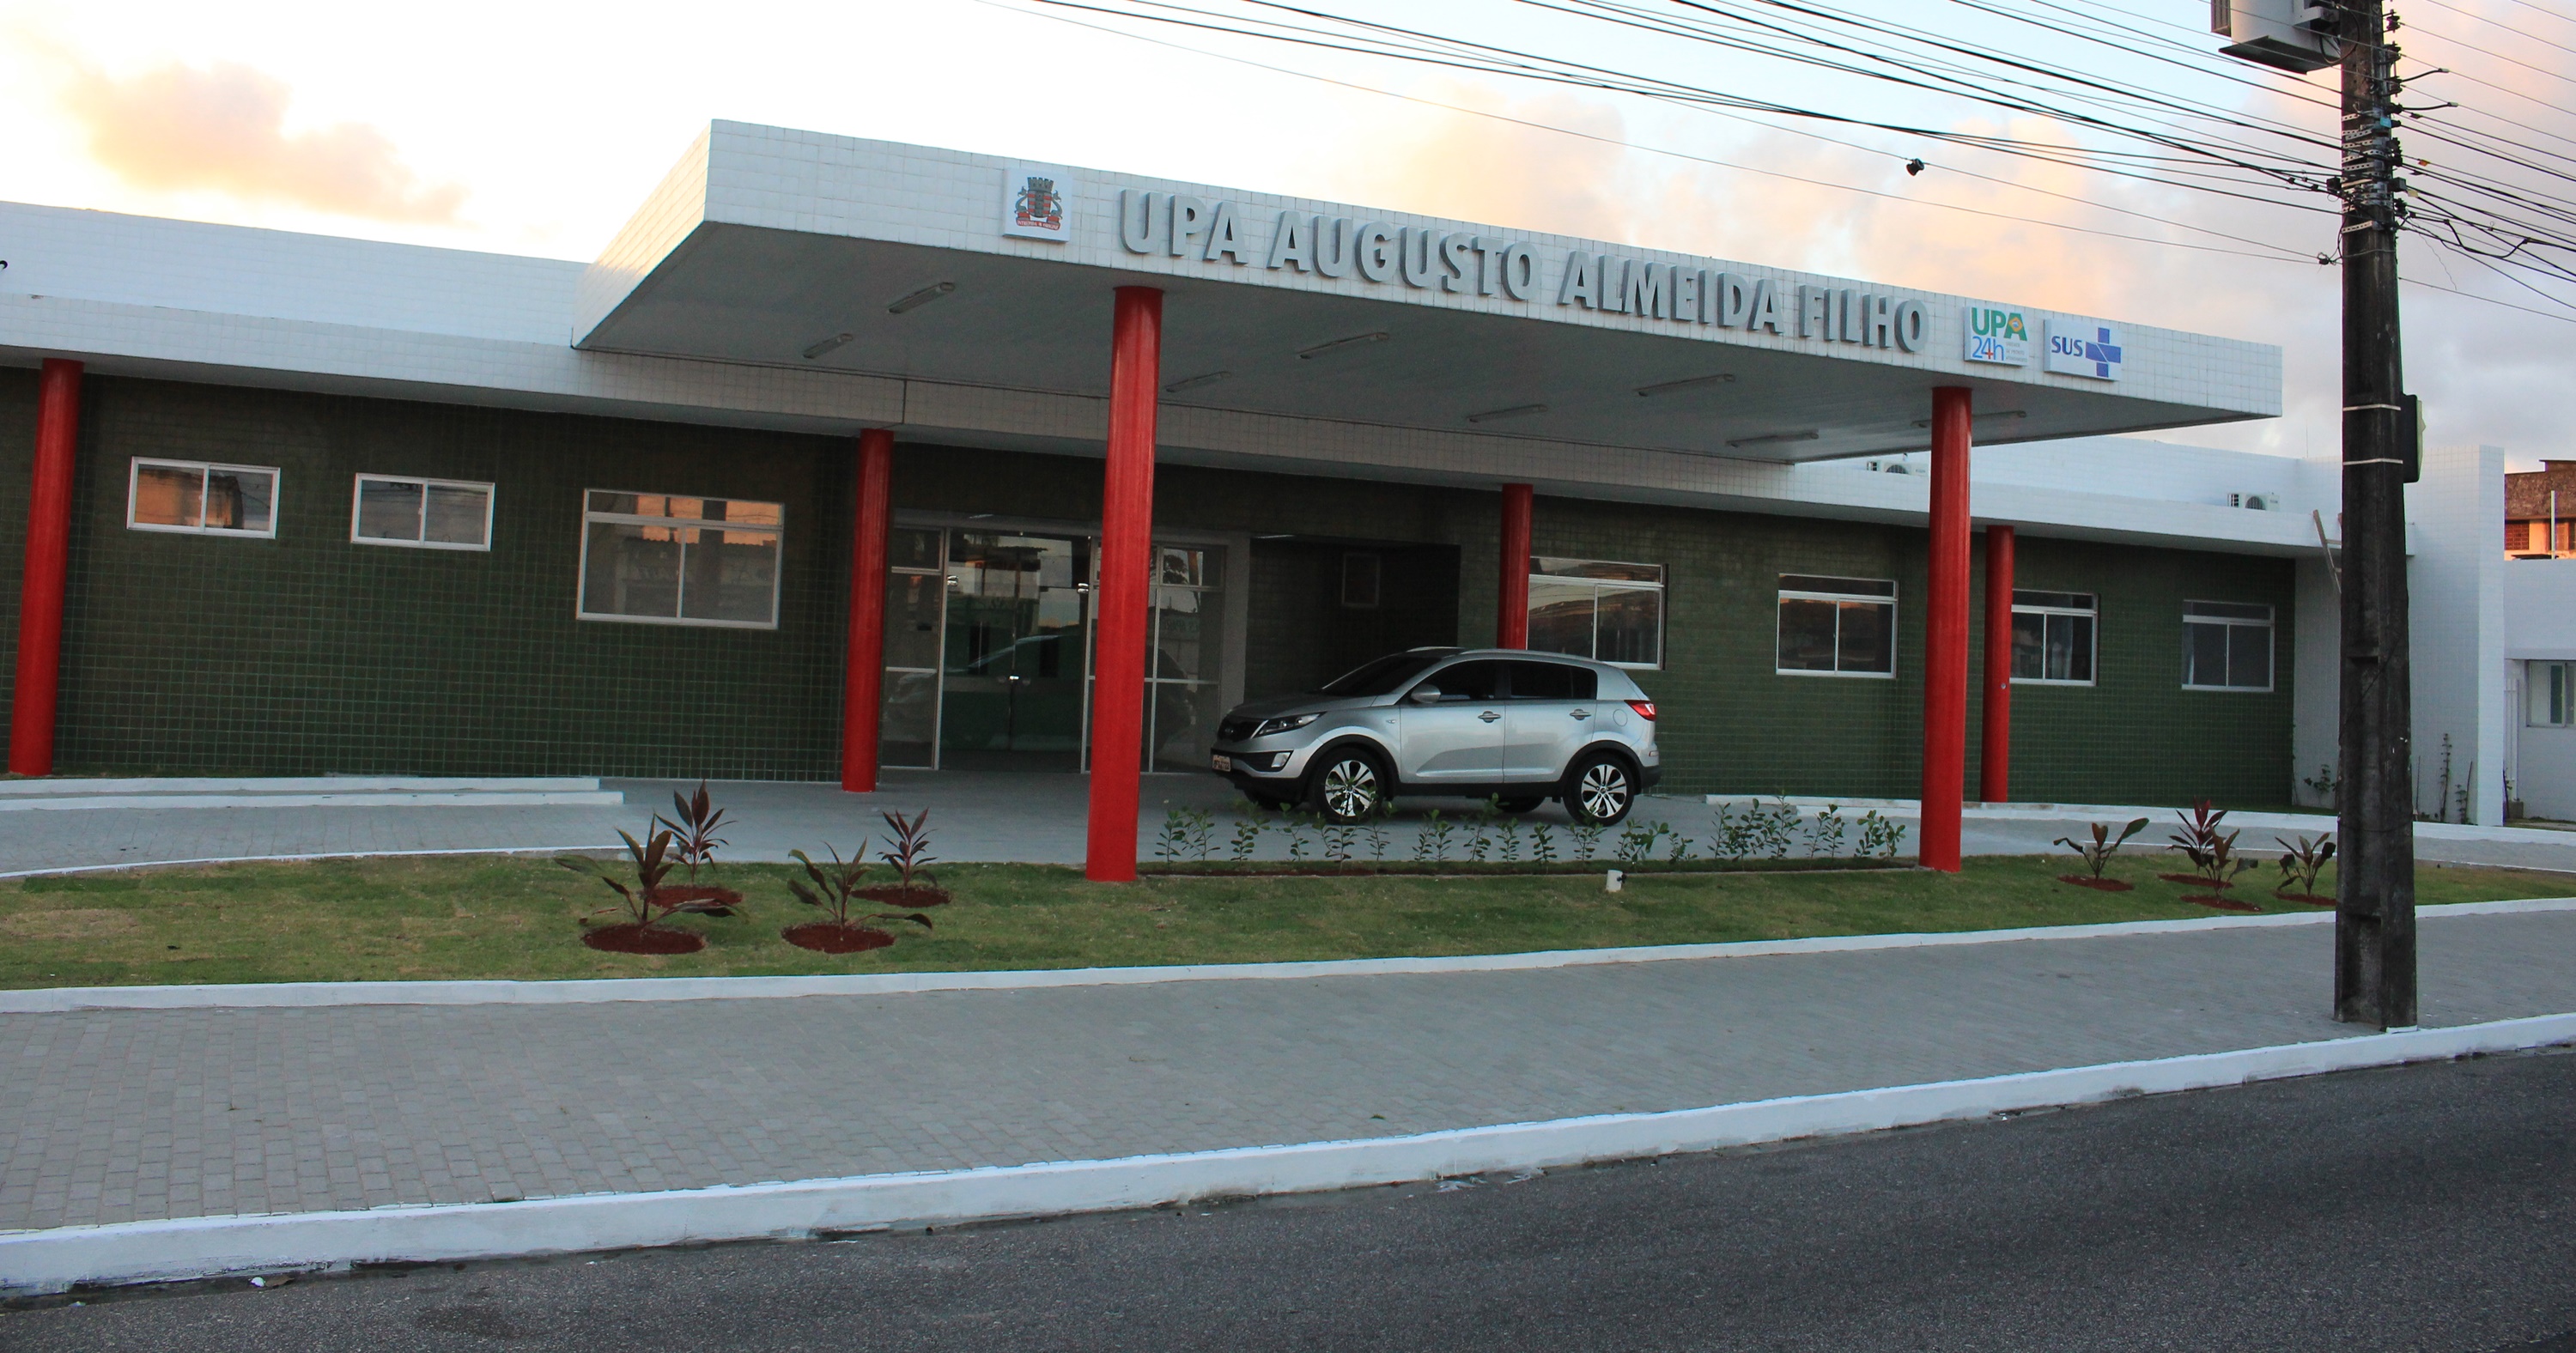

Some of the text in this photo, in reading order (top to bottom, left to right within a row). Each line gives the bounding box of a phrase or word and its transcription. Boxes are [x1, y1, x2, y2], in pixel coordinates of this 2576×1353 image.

[1120, 188, 1929, 353] UPA AUGUSTO ALMEIDA FILHO
[1971, 306, 2028, 342] UPA
[1971, 335, 2005, 361] 24h
[2050, 335, 2083, 357] SUS
